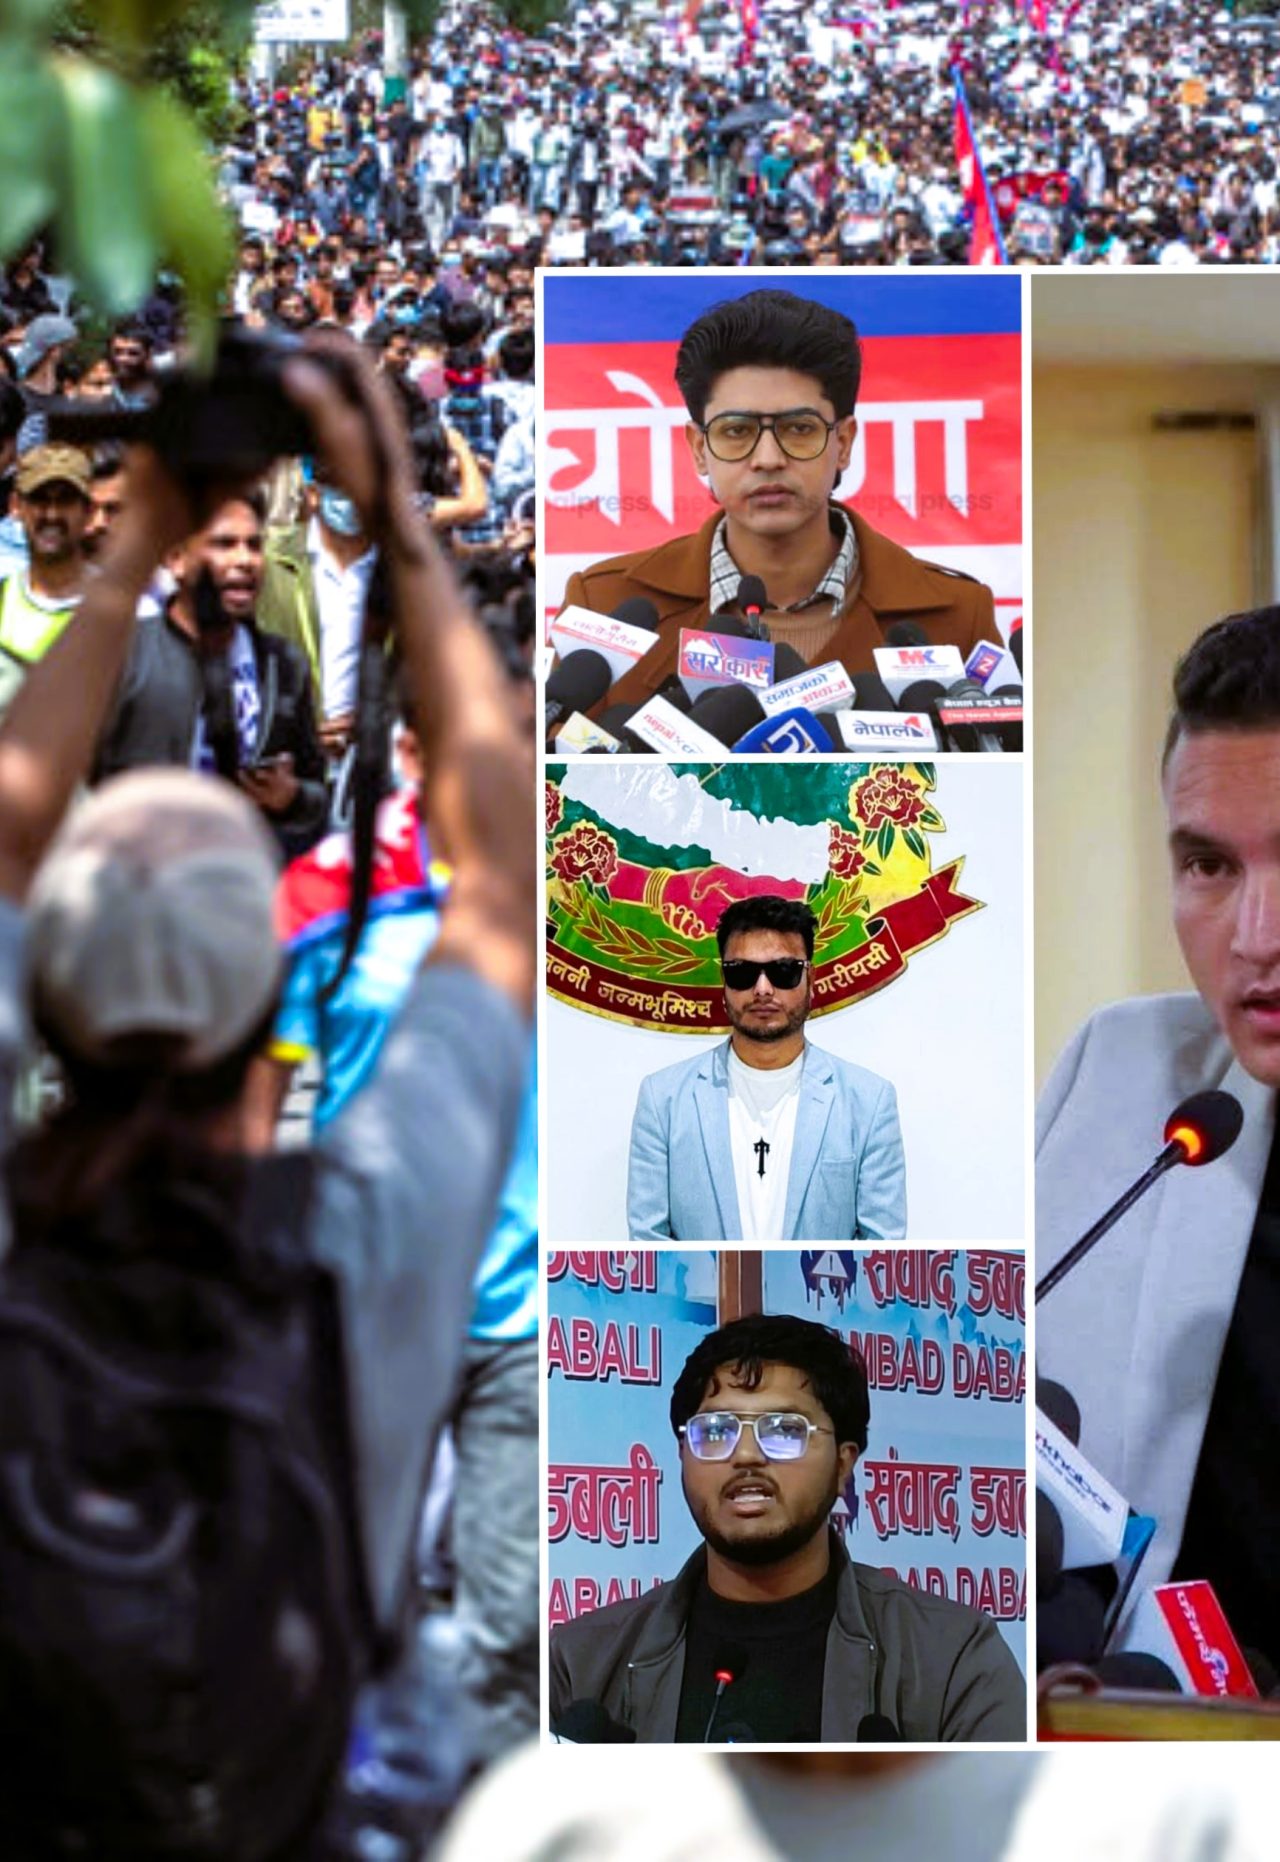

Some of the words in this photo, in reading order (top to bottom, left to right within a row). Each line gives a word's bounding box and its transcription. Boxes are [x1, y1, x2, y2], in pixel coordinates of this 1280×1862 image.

[544, 371, 984, 526] घोणा
[852, 719, 910, 737] नेपाल
[863, 1446, 961, 1543] संवाद
